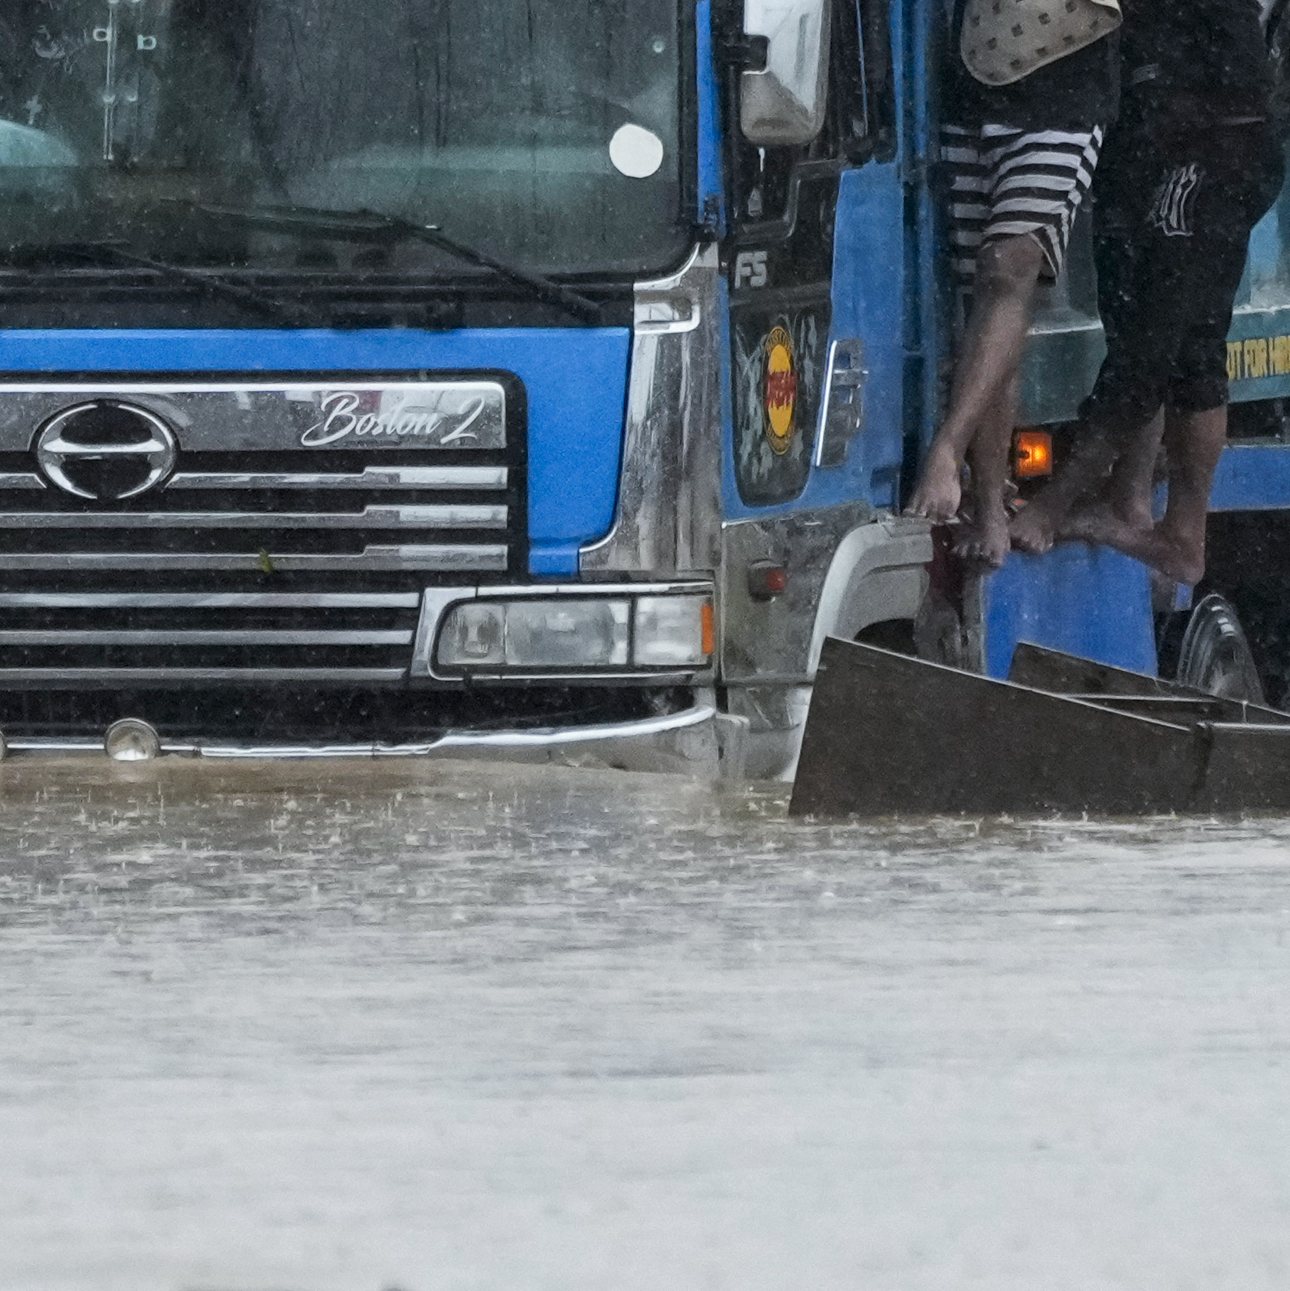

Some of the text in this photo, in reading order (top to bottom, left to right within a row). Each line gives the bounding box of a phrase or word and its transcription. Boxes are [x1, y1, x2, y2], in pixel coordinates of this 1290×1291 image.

[1226, 341, 1243, 381] OT
[1244, 338, 1267, 379] FOR
[301, 392, 485, 447] Boston 2
